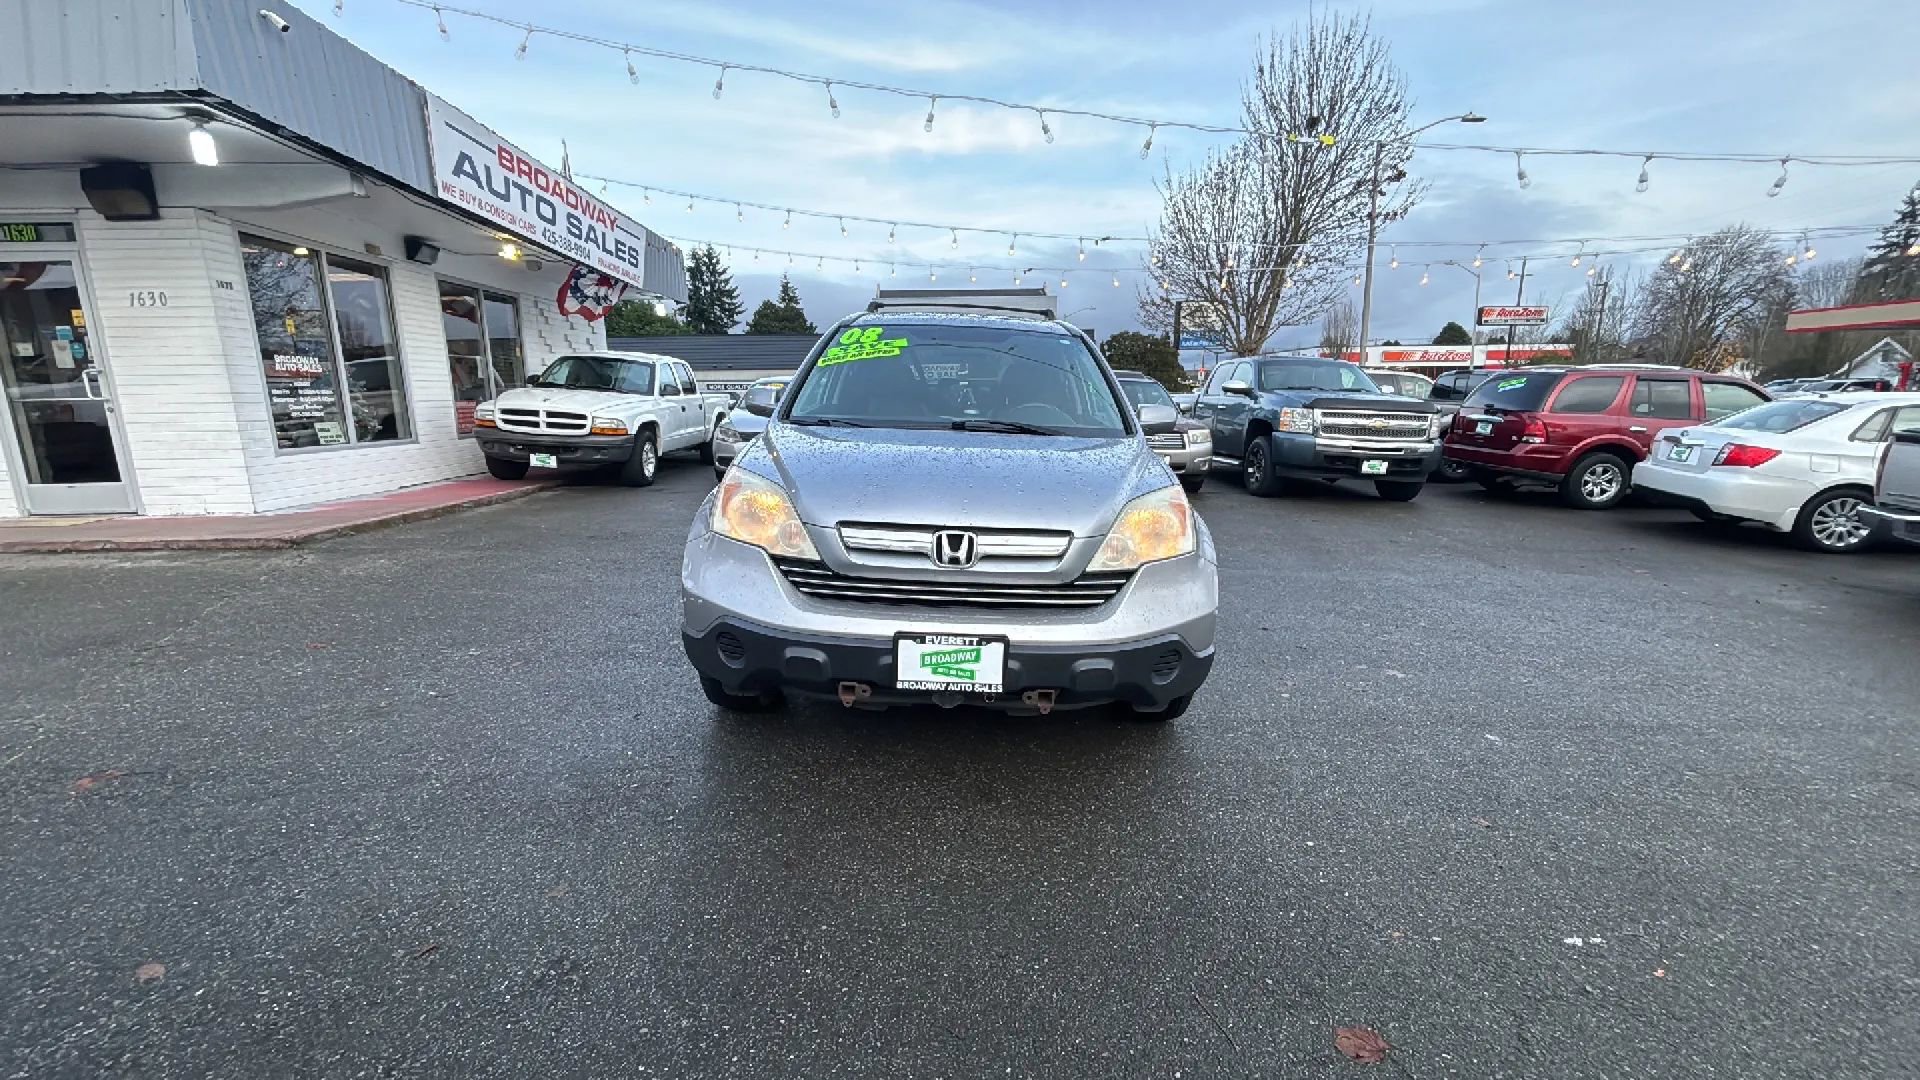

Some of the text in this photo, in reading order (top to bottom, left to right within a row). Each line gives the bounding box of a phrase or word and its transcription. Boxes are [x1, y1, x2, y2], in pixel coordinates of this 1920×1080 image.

[497, 144, 618, 232] BROADWAY
[441, 180, 457, 198] WE
[459, 189, 476, 207] BUY
[484, 201, 517, 227] CONSIGN
[518, 218, 537, 235] CARS
[452, 150, 640, 269] AUTO SALES
[3, 224, 37, 241] 1630
[129, 291, 168, 307] 1630
[274, 354, 319, 364] BROADWAY
[925, 636, 979, 646] EVERETT
[924, 651, 977, 665] BROADWAY
[896, 681, 1003, 693] BROADWAY AUTO SALES
